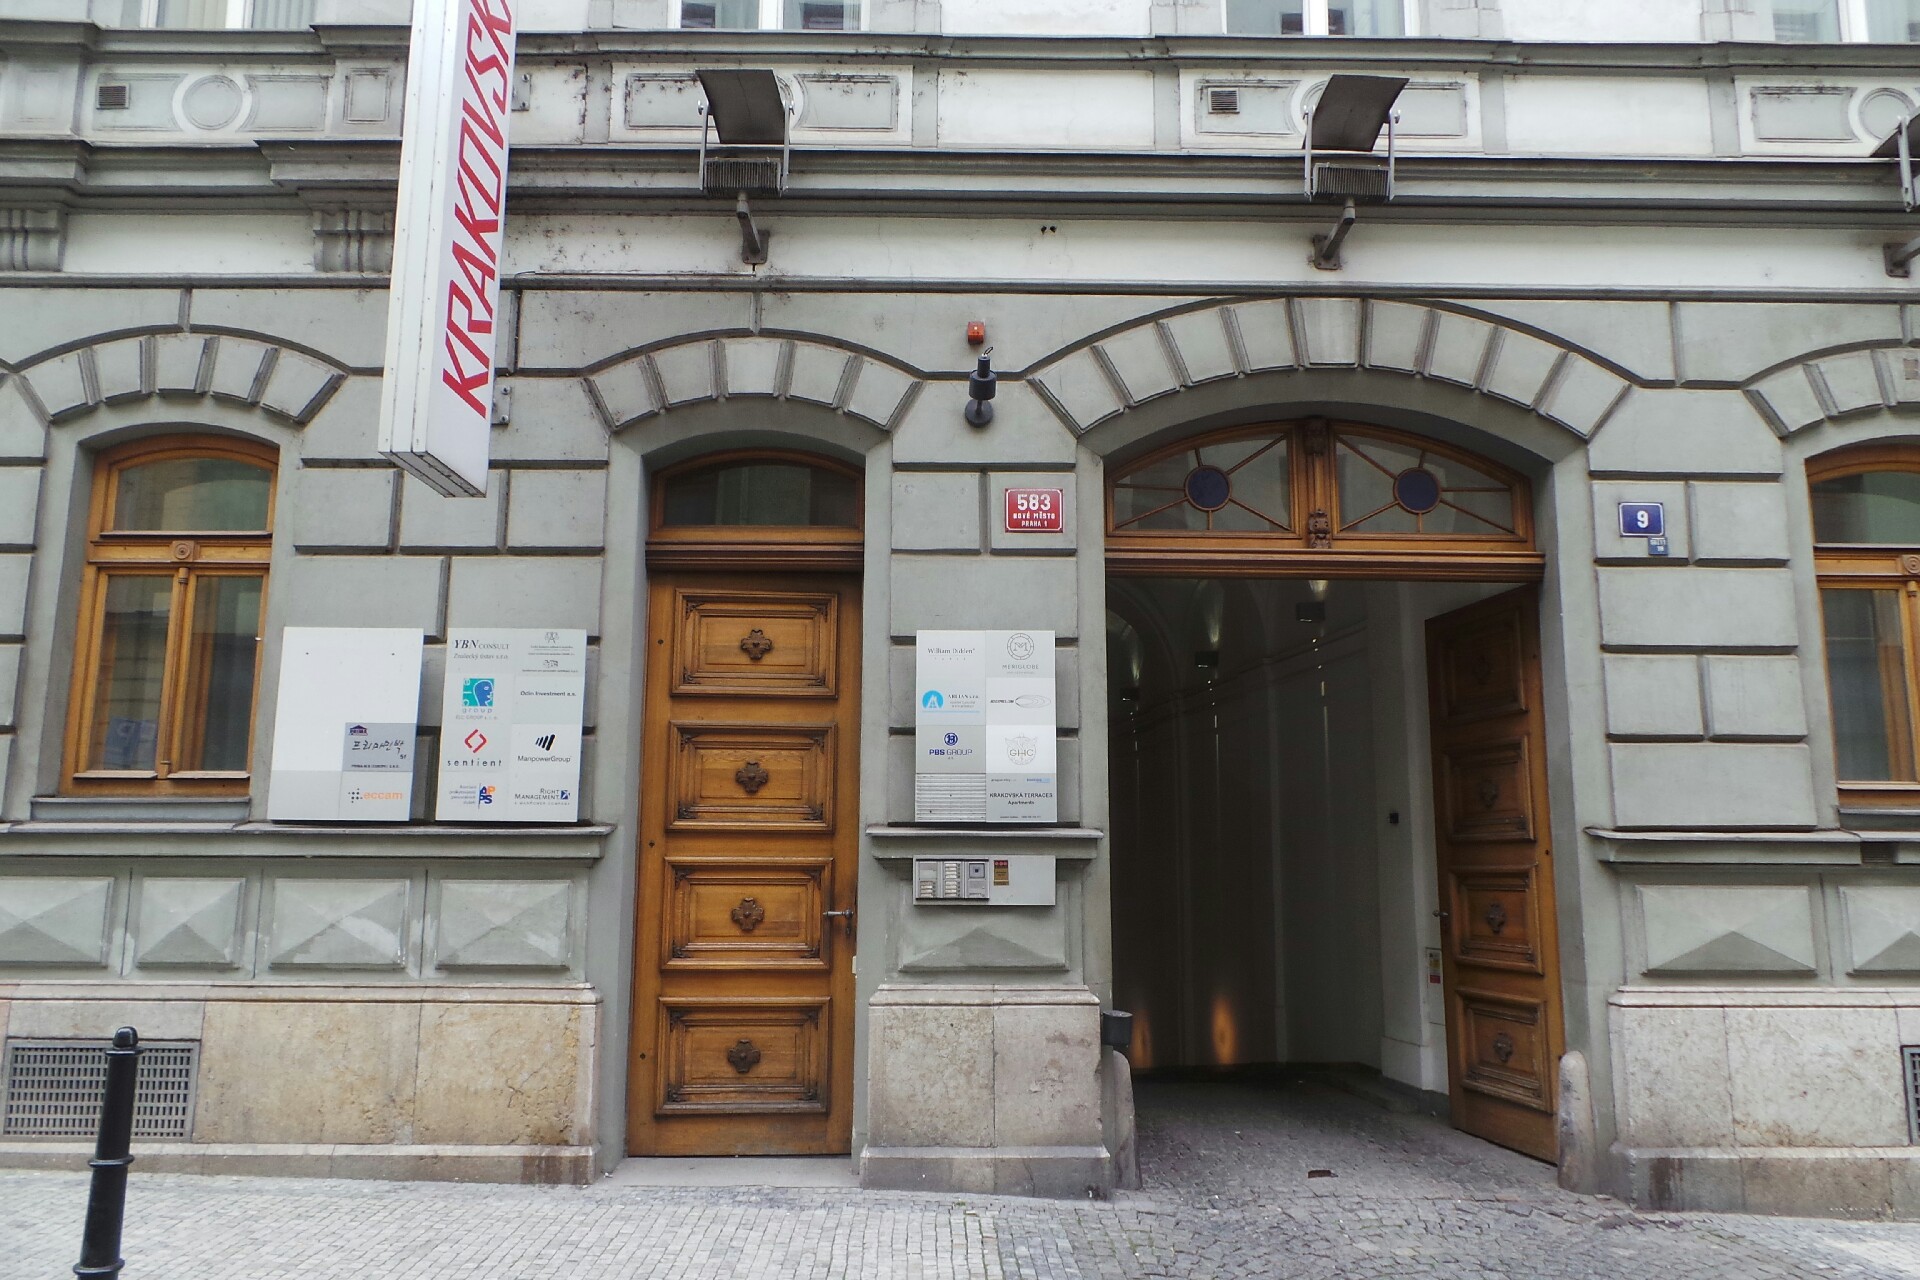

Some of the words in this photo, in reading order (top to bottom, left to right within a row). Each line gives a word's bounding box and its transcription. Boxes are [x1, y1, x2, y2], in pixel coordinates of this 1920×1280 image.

[443, 0, 511, 419] KRAKOVSK
[1017, 493, 1051, 511] 583
[1012, 511, 1031, 519] NOVÉ
[1033, 511, 1056, 519] MĚSTO
[1636, 510, 1649, 529] 9
[453, 639, 479, 649] YBN
[928, 748, 945, 756] PBS
[946, 748, 973, 756] GROUP
[1008, 748, 1034, 757] GHC
[447, 758, 502, 767] sentient
[517, 755, 571, 763] ManpowerGroup
[363, 790, 403, 800] eccam
[540, 787, 560, 795] RIGHT
